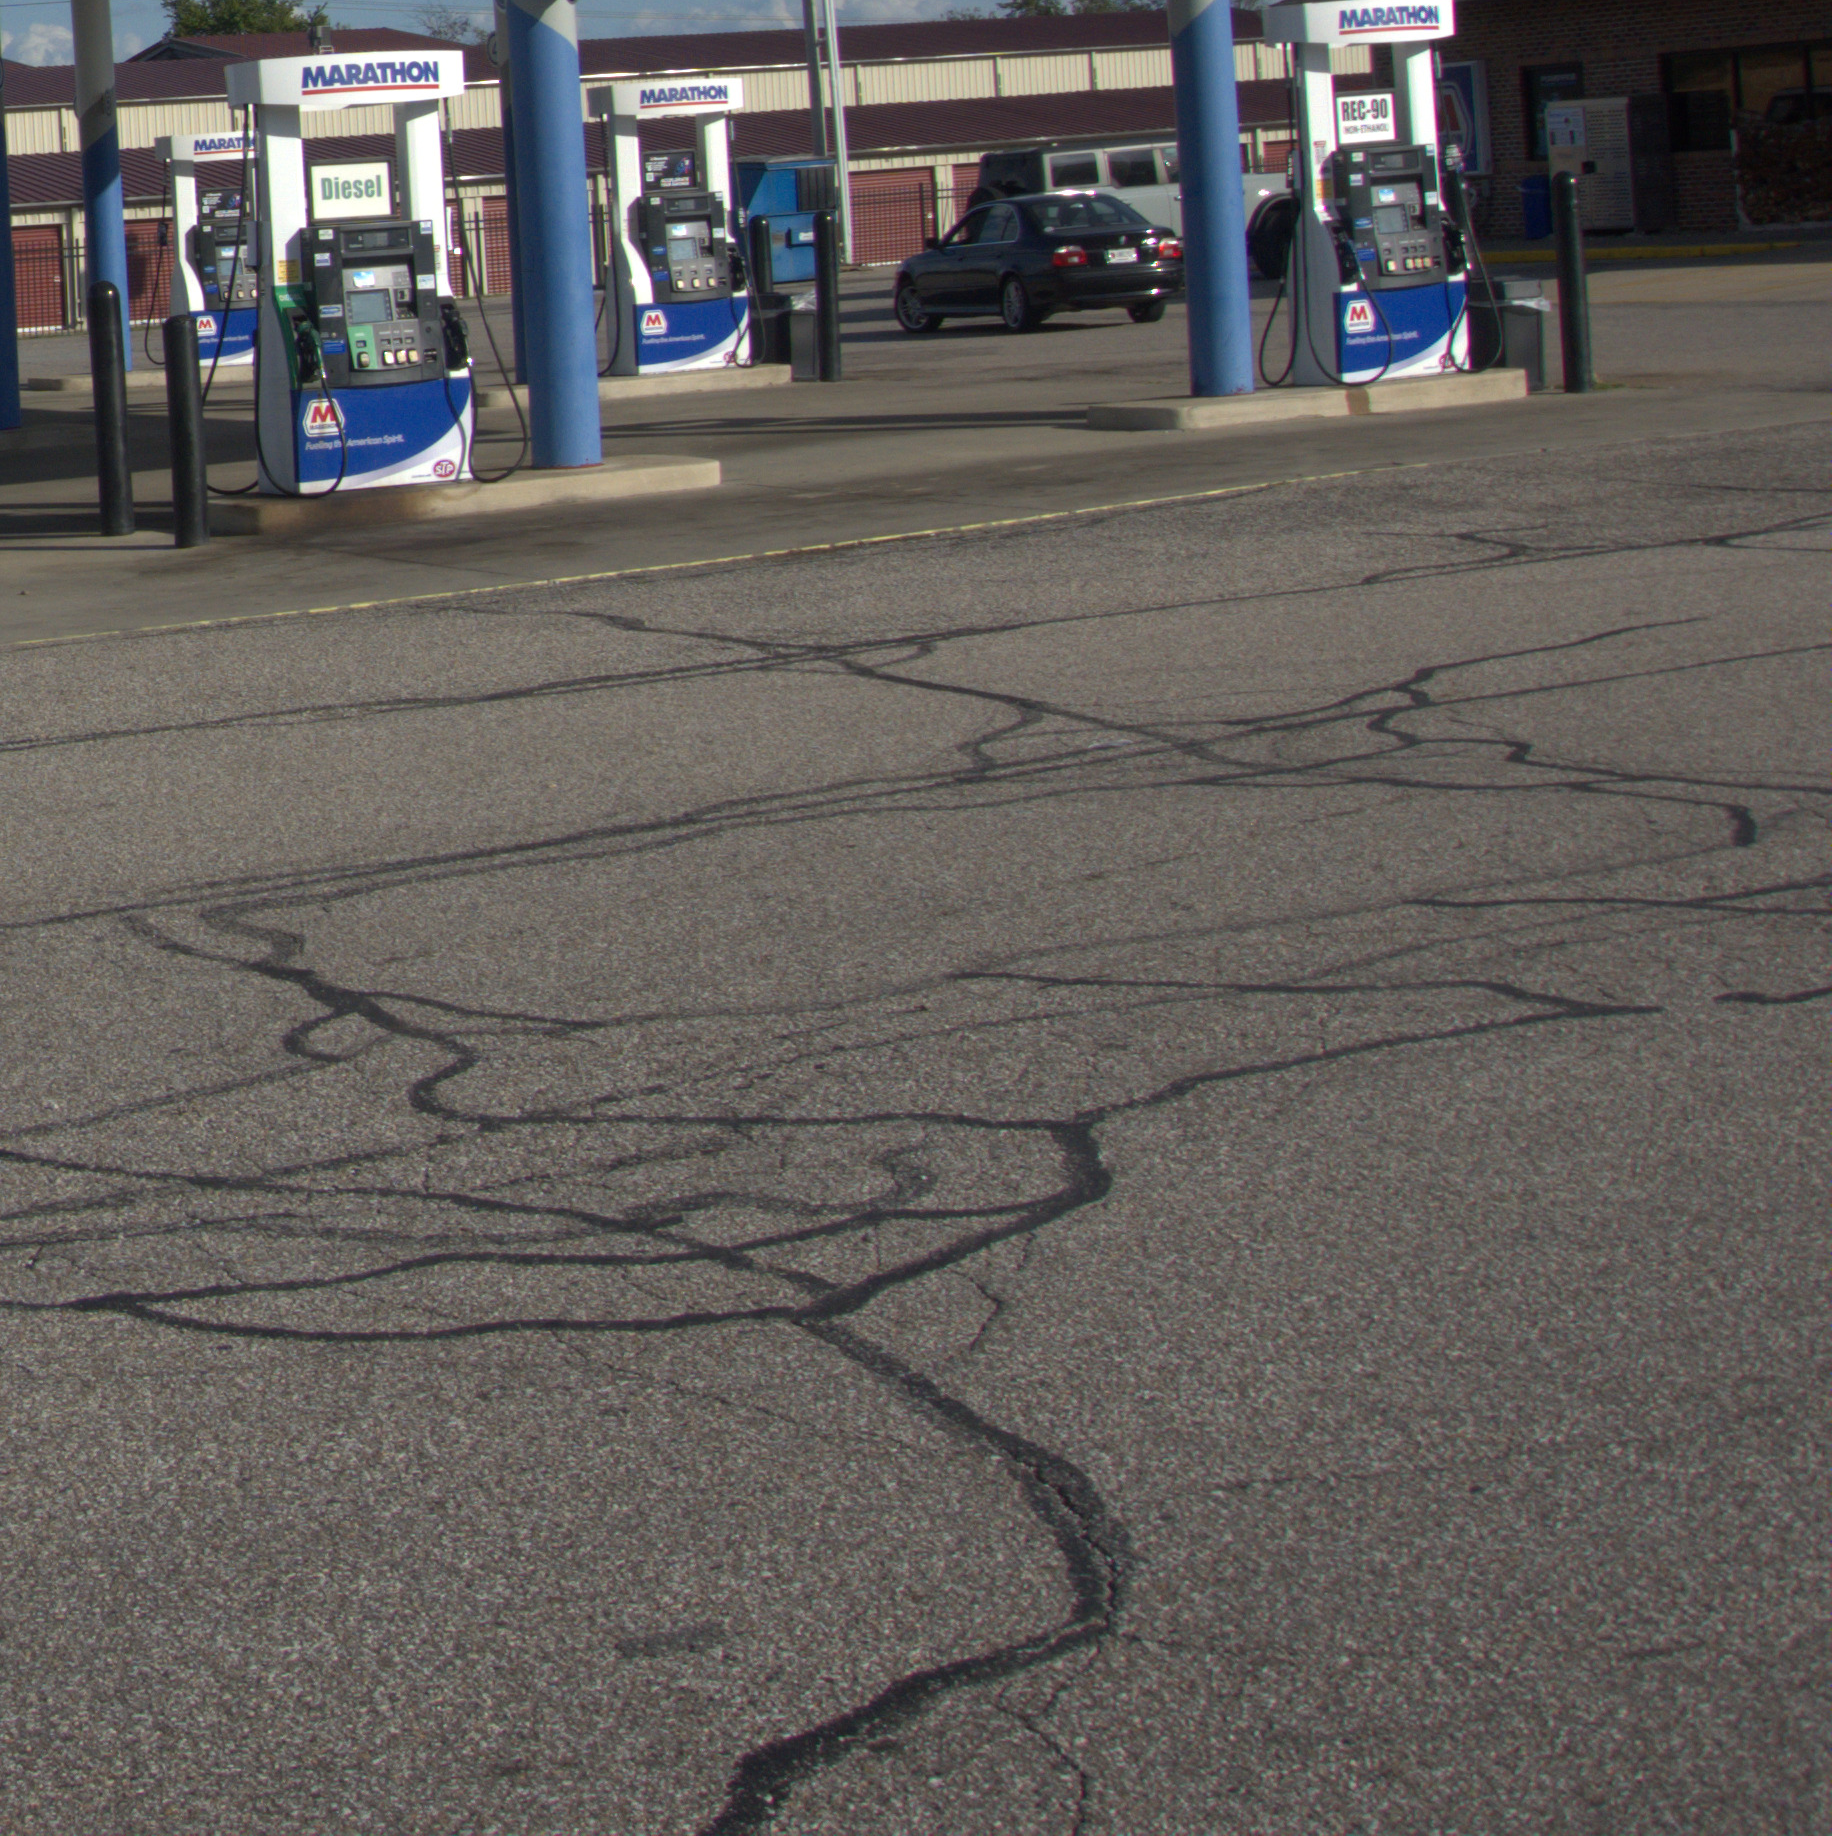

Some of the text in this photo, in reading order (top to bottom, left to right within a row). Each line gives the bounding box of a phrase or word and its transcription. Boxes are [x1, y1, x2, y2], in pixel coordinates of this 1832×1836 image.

[1339, 5, 1440, 29] MARATHON
[302, 60, 440, 88] MARATHON
[640, 85, 728, 104] MARATHON
[1341, 98, 1388, 122] REC-90
[194, 137, 255, 152] MARAT
[320, 174, 383, 201] Diesel
[646, 314, 662, 326] M
[1350, 305, 1368, 322] M
[198, 319, 212, 329] M
[311, 405, 337, 423] M
[305, 440, 333, 450] Fueling
[346, 436, 383, 447] American
[435, 461, 454, 476] STP
